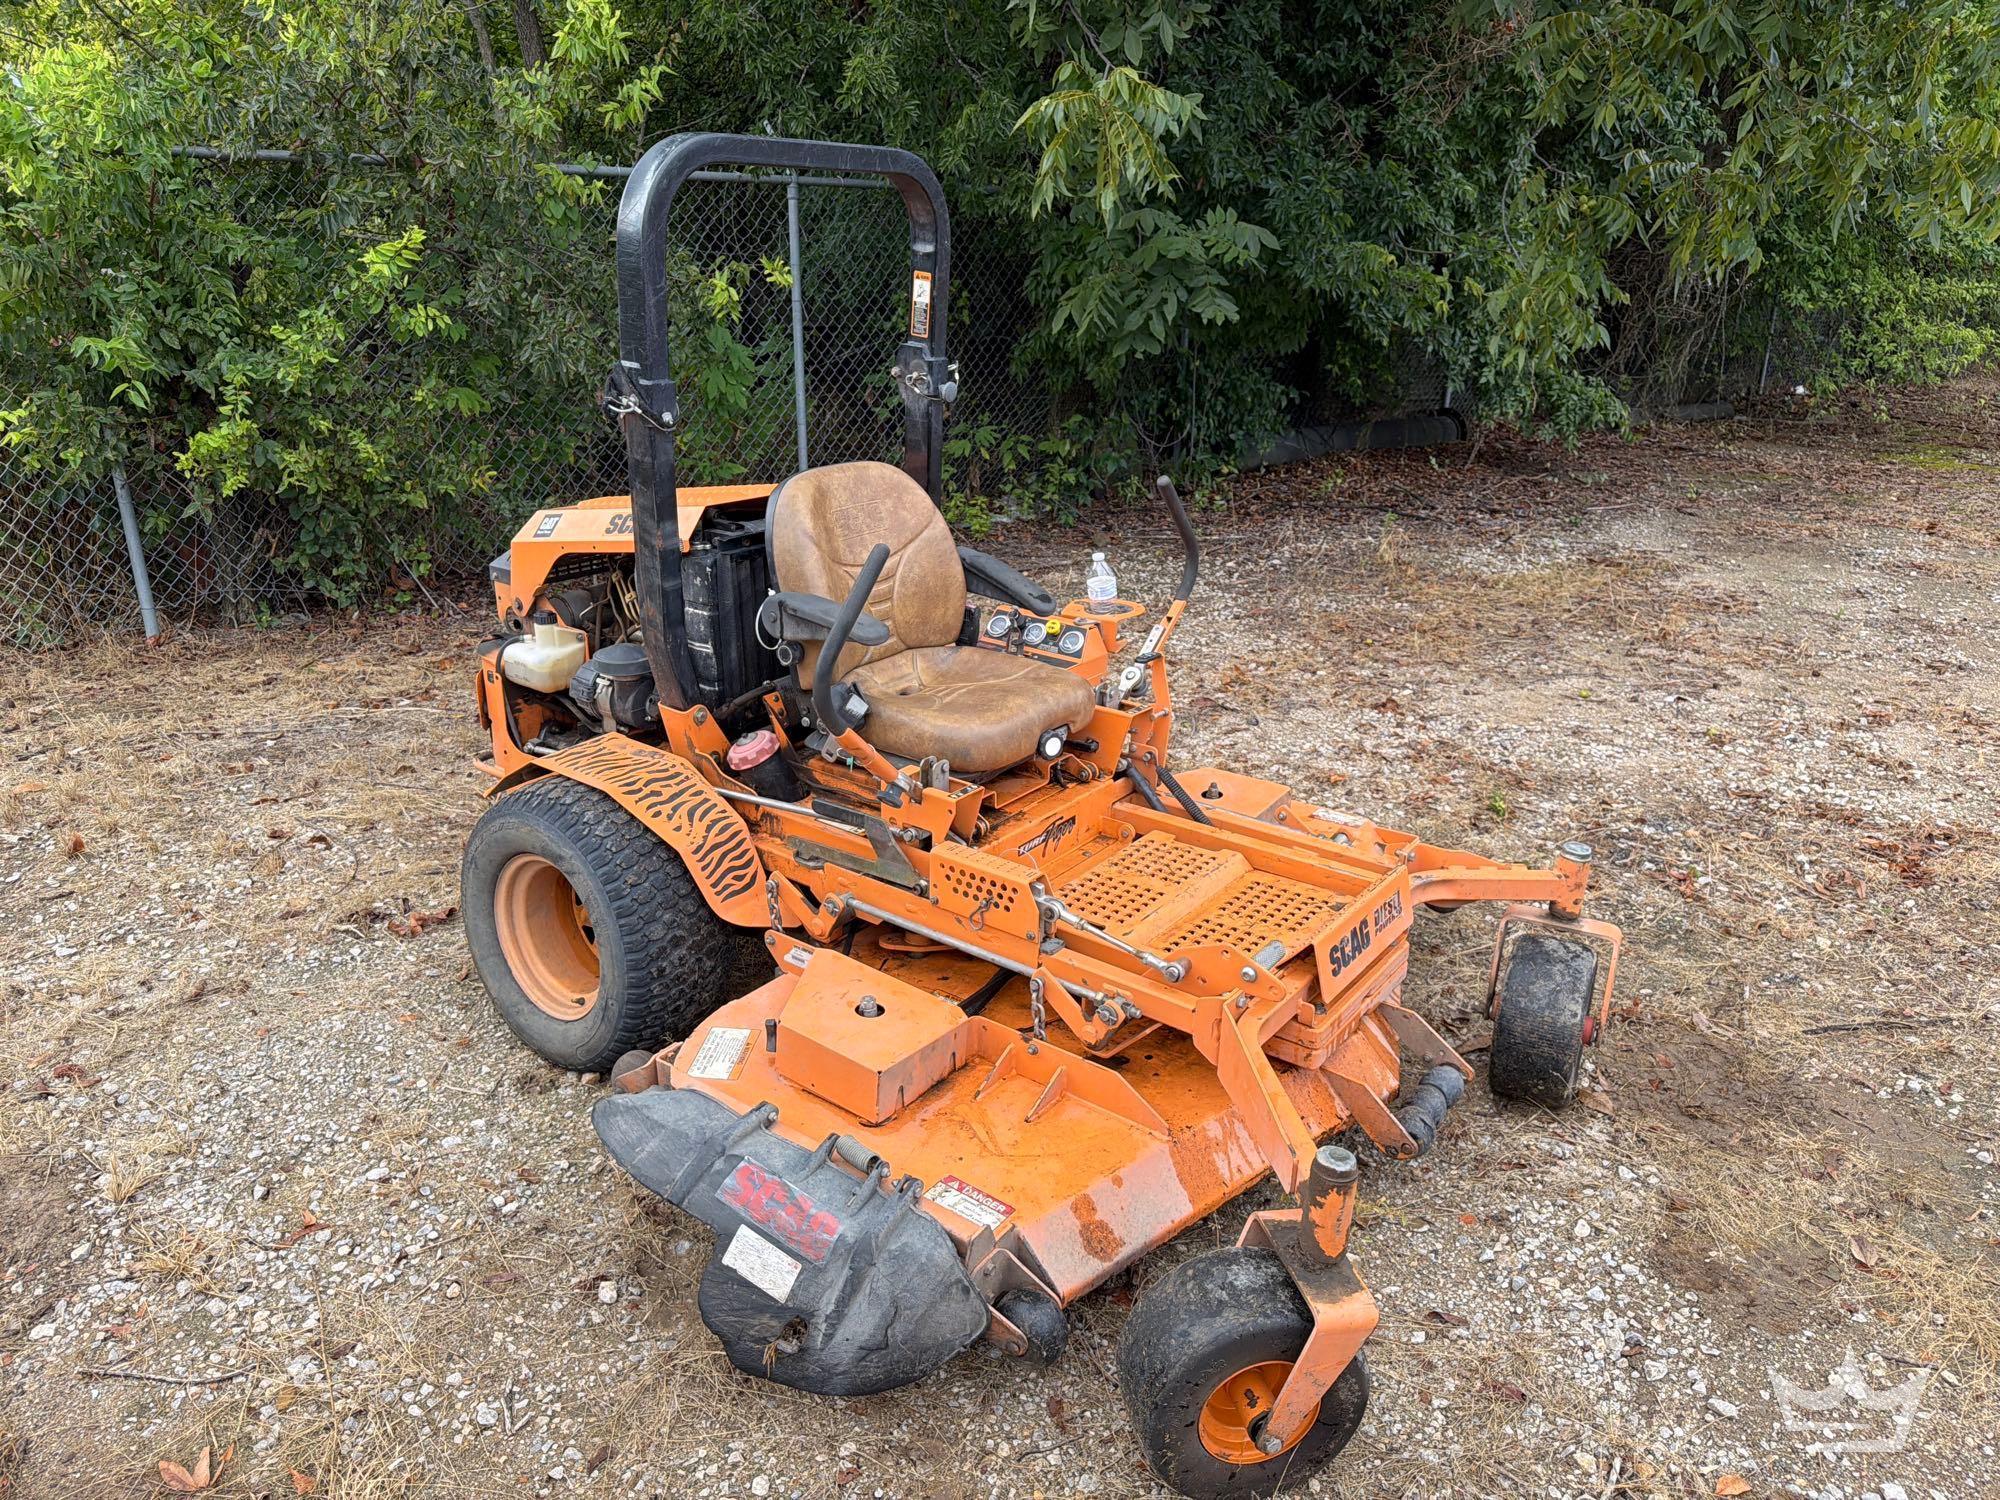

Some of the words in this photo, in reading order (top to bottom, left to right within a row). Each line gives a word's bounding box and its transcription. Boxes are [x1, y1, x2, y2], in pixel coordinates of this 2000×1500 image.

[540, 517, 560, 530] CAT
[1329, 918, 1371, 977] SCAG
[723, 1164, 841, 1262] SCAG
[962, 1186, 1006, 1212] DANGER
